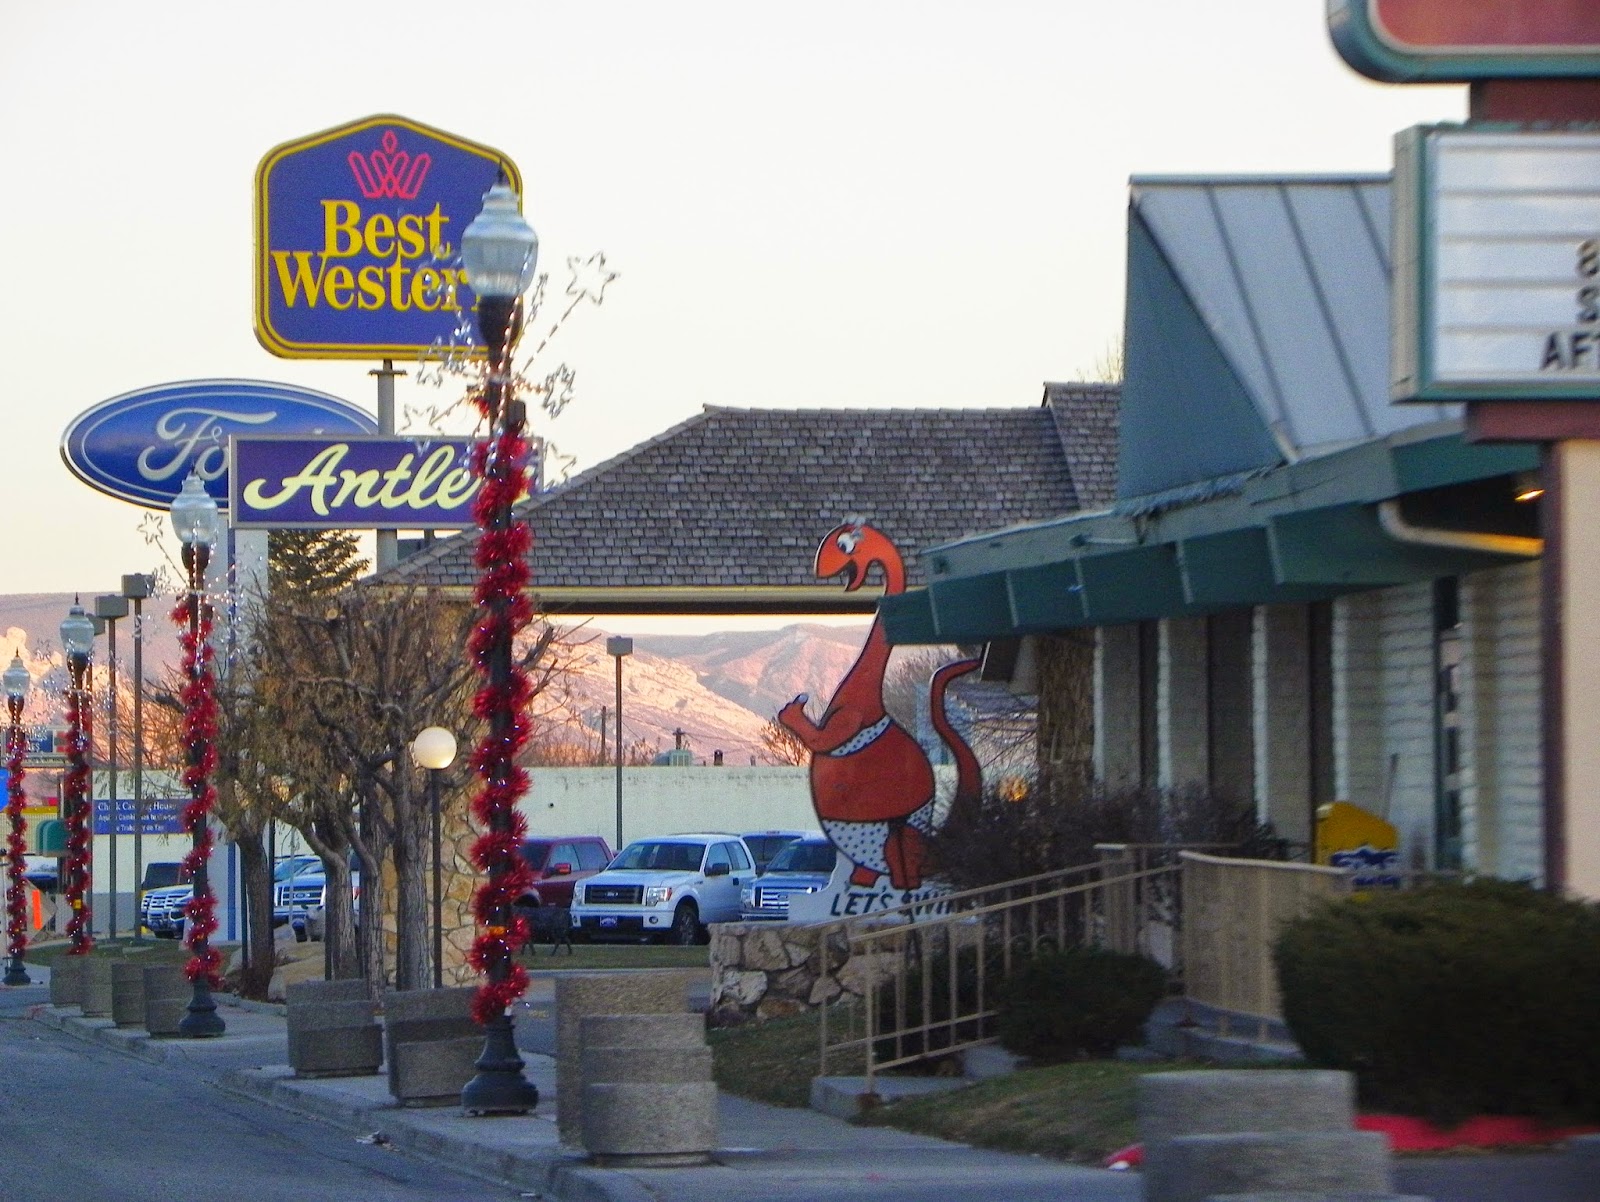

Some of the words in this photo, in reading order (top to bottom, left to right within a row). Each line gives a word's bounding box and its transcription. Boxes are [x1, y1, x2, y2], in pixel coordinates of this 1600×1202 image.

[320, 200, 451, 259] Best
[269, 251, 481, 312] Wester
[138, 407, 277, 481] Fo
[243, 443, 531, 516] Antle
[831, 885, 894, 916] LET'S
